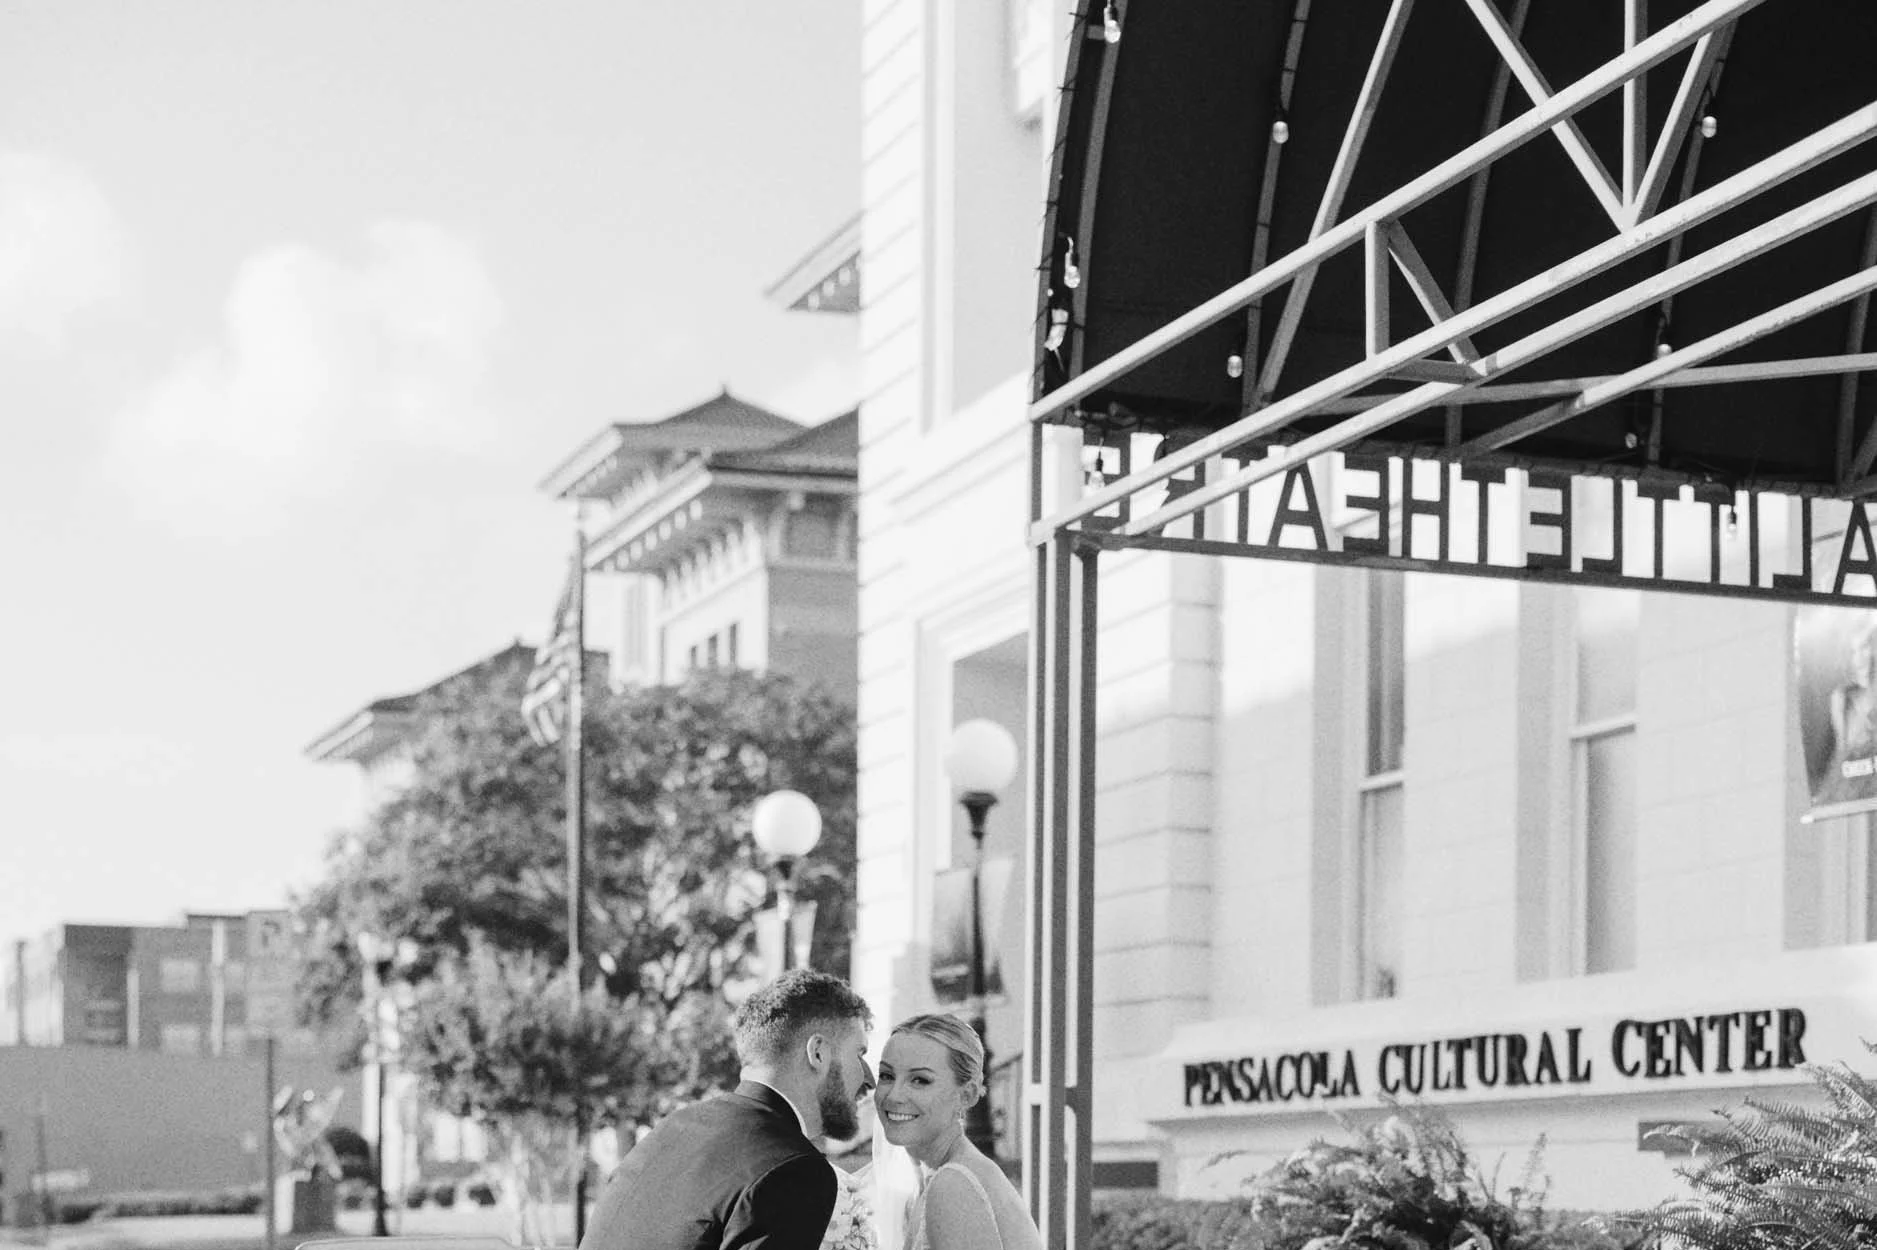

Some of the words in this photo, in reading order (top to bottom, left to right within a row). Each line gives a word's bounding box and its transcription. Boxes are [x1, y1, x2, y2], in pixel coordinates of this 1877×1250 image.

[1184, 1049, 1361, 1107] PENSACOLA
[1378, 1028, 1592, 1095] CULTURAL
[1612, 1008, 1808, 1079] CENTER
